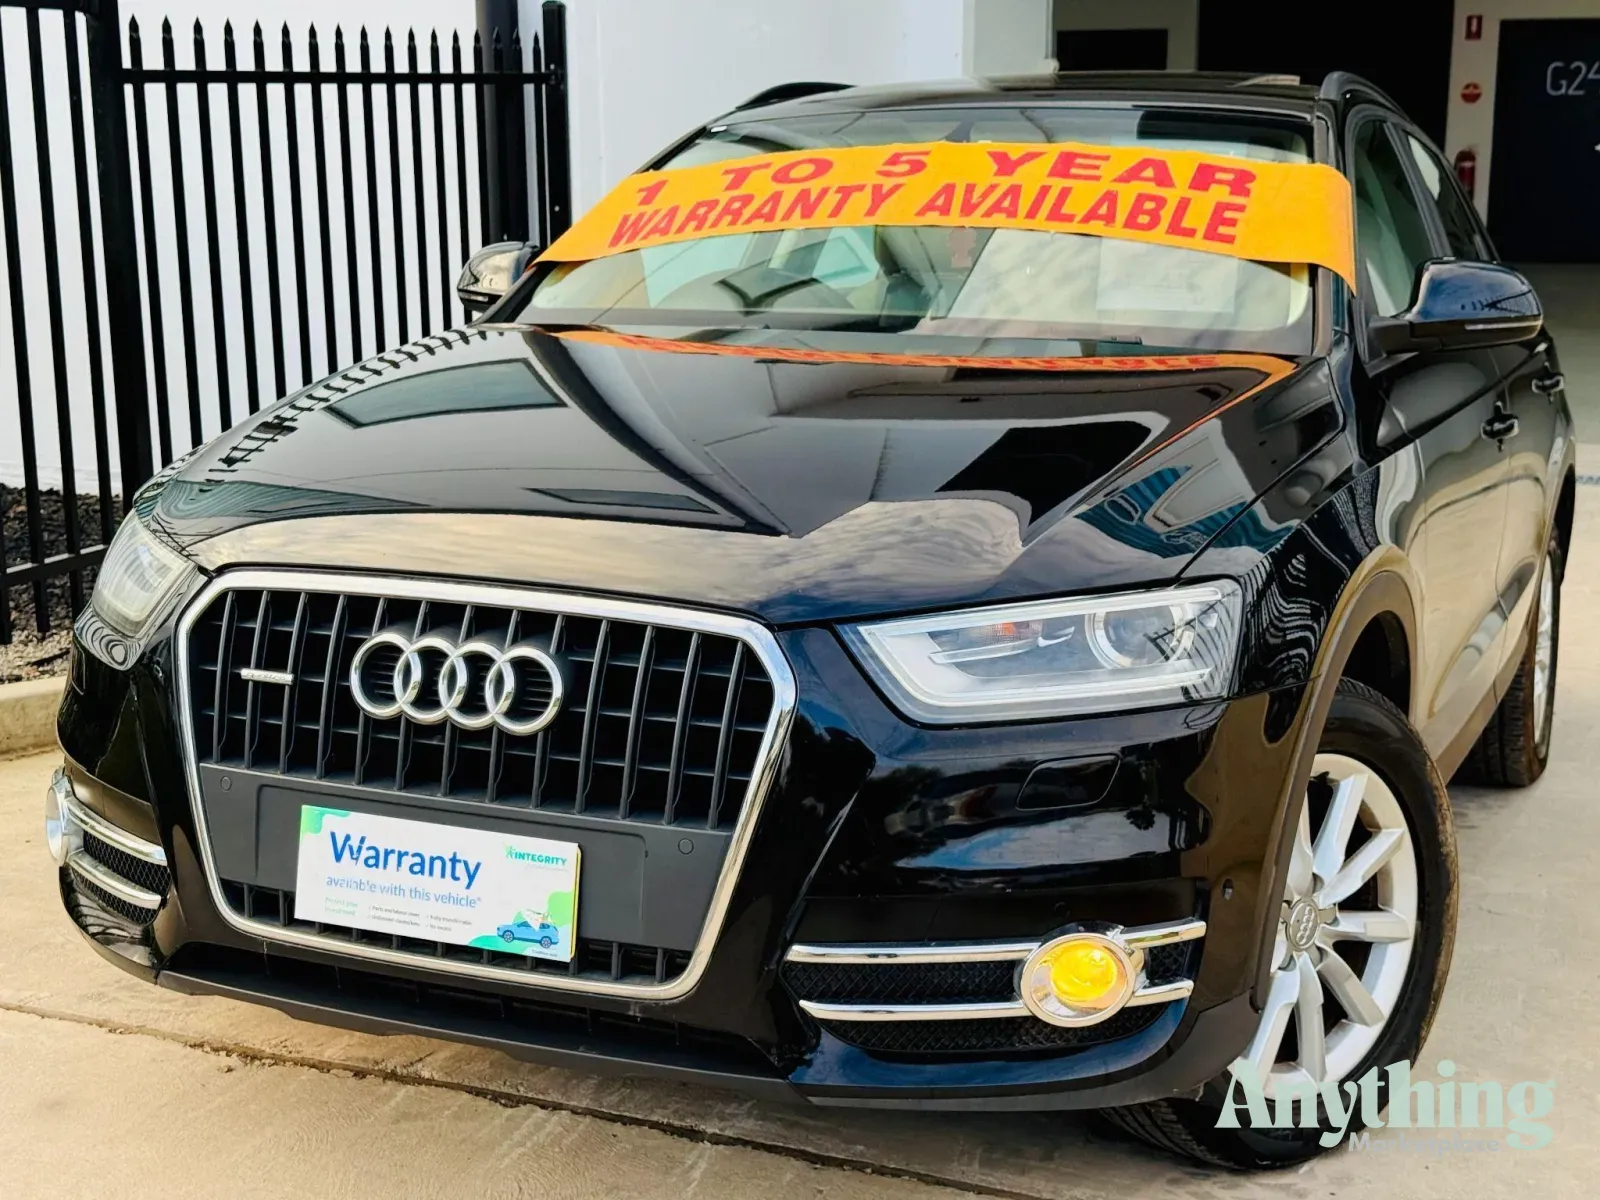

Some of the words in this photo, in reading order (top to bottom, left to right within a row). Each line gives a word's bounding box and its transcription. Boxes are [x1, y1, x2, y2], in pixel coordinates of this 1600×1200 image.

[636, 180, 668, 206] 1
[721, 157, 834, 191] TO
[876, 151, 932, 178] 5
[986, 151, 1257, 198] YEAR
[608, 183, 906, 248] WARRANTY
[914, 183, 1247, 244] AVAILABLE
[330, 831, 482, 890] Warranty
[514, 851, 568, 866] INTEGRITY
[380, 882, 406, 897] with
[409, 886, 431, 903] this
